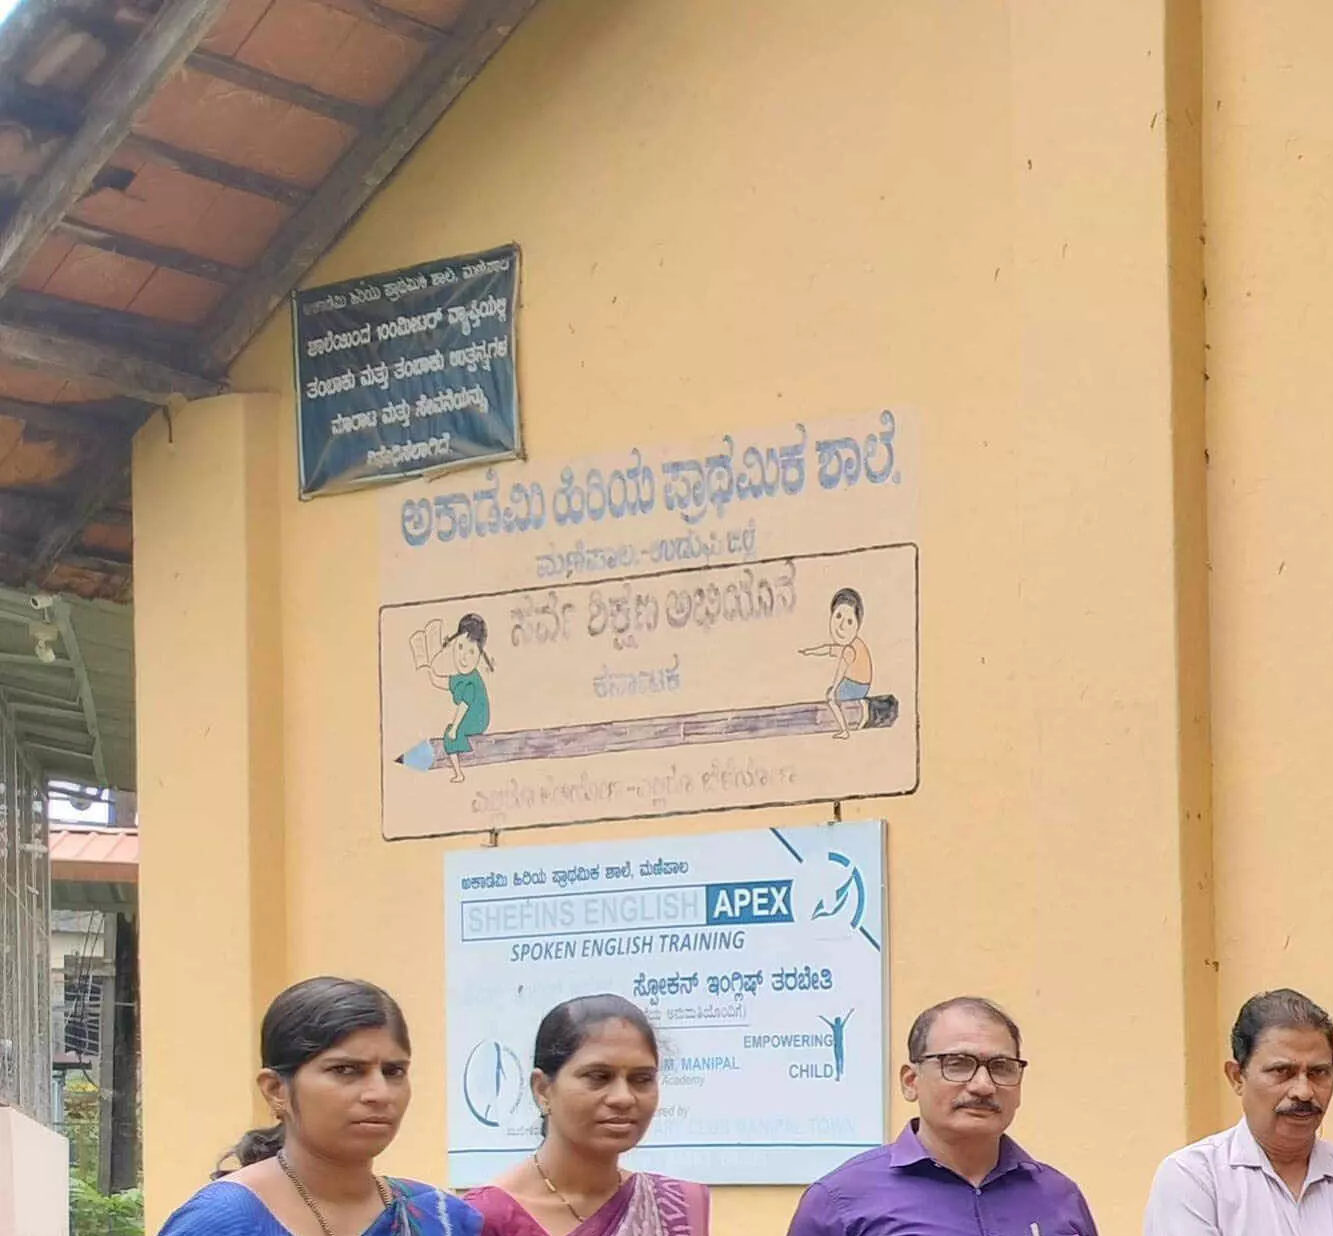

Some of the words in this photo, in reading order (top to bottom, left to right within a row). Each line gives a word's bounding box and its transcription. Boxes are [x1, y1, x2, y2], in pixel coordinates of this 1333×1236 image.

[401, 469, 546, 546] ಅಕಾಡೆಮಿ
[554, 448, 655, 526] ಹಿರಿಯ
[663, 423, 806, 523] ಪ್ರಾಥಮಿಕ
[469, 900, 575, 932] SHEFINS
[585, 893, 698, 925] ENGLISH
[714, 886, 789, 918] APEX
[510, 940, 576, 962] SPOKEN
[582, 936, 653, 958] ENGLISH
[659, 930, 746, 953] TRAINING
[771, 966, 833, 992] ತರಬೇತಿ
[743, 1033, 834, 1049] EMPOWERING
[681, 1056, 740, 1071] MANIPAL
[788, 1063, 834, 1079] CHILD
